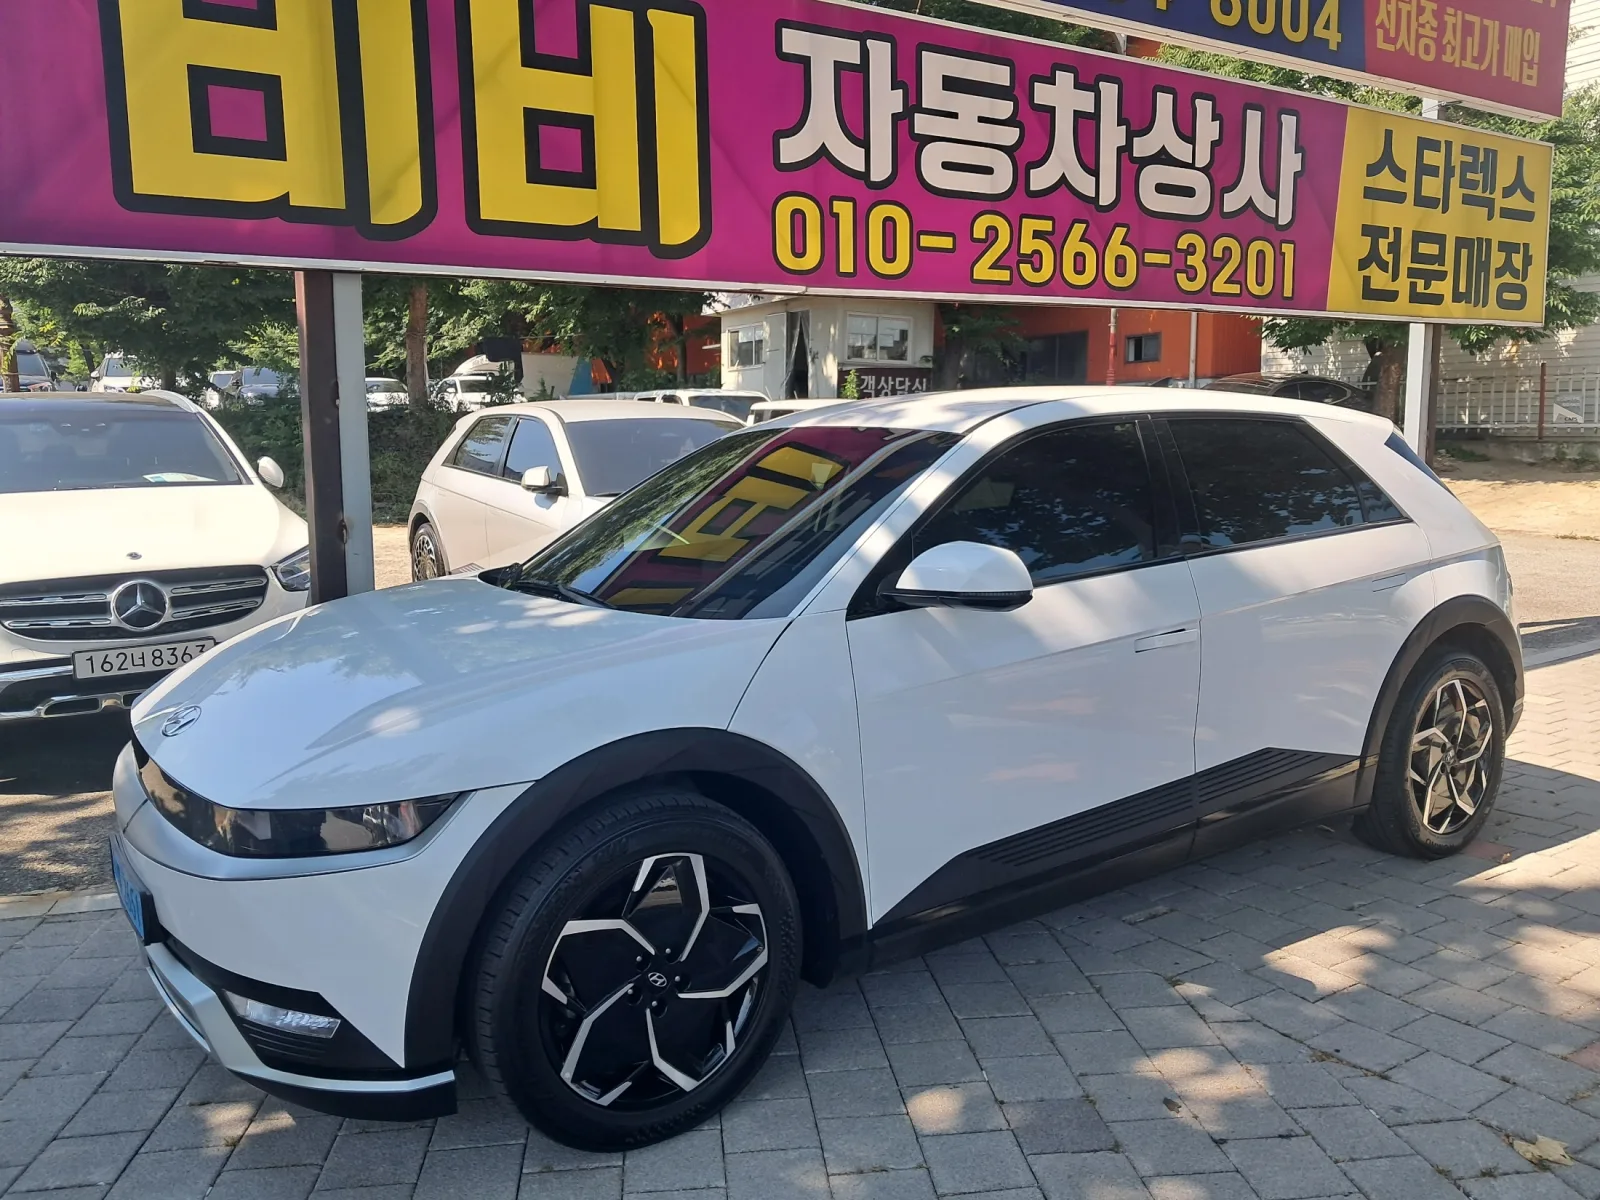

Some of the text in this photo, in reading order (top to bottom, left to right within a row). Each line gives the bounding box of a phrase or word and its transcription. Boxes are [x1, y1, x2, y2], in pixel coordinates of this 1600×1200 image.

[1441, 7, 1500, 77] 최고가
[1503, 24, 1541, 87] 매입
[777, 24, 1305, 228] 자동차상사
[1362, 128, 1536, 223] 스타렉스
[772, 196, 1297, 298] 010-2566-3201
[1357, 223, 1533, 311] 전문매장
